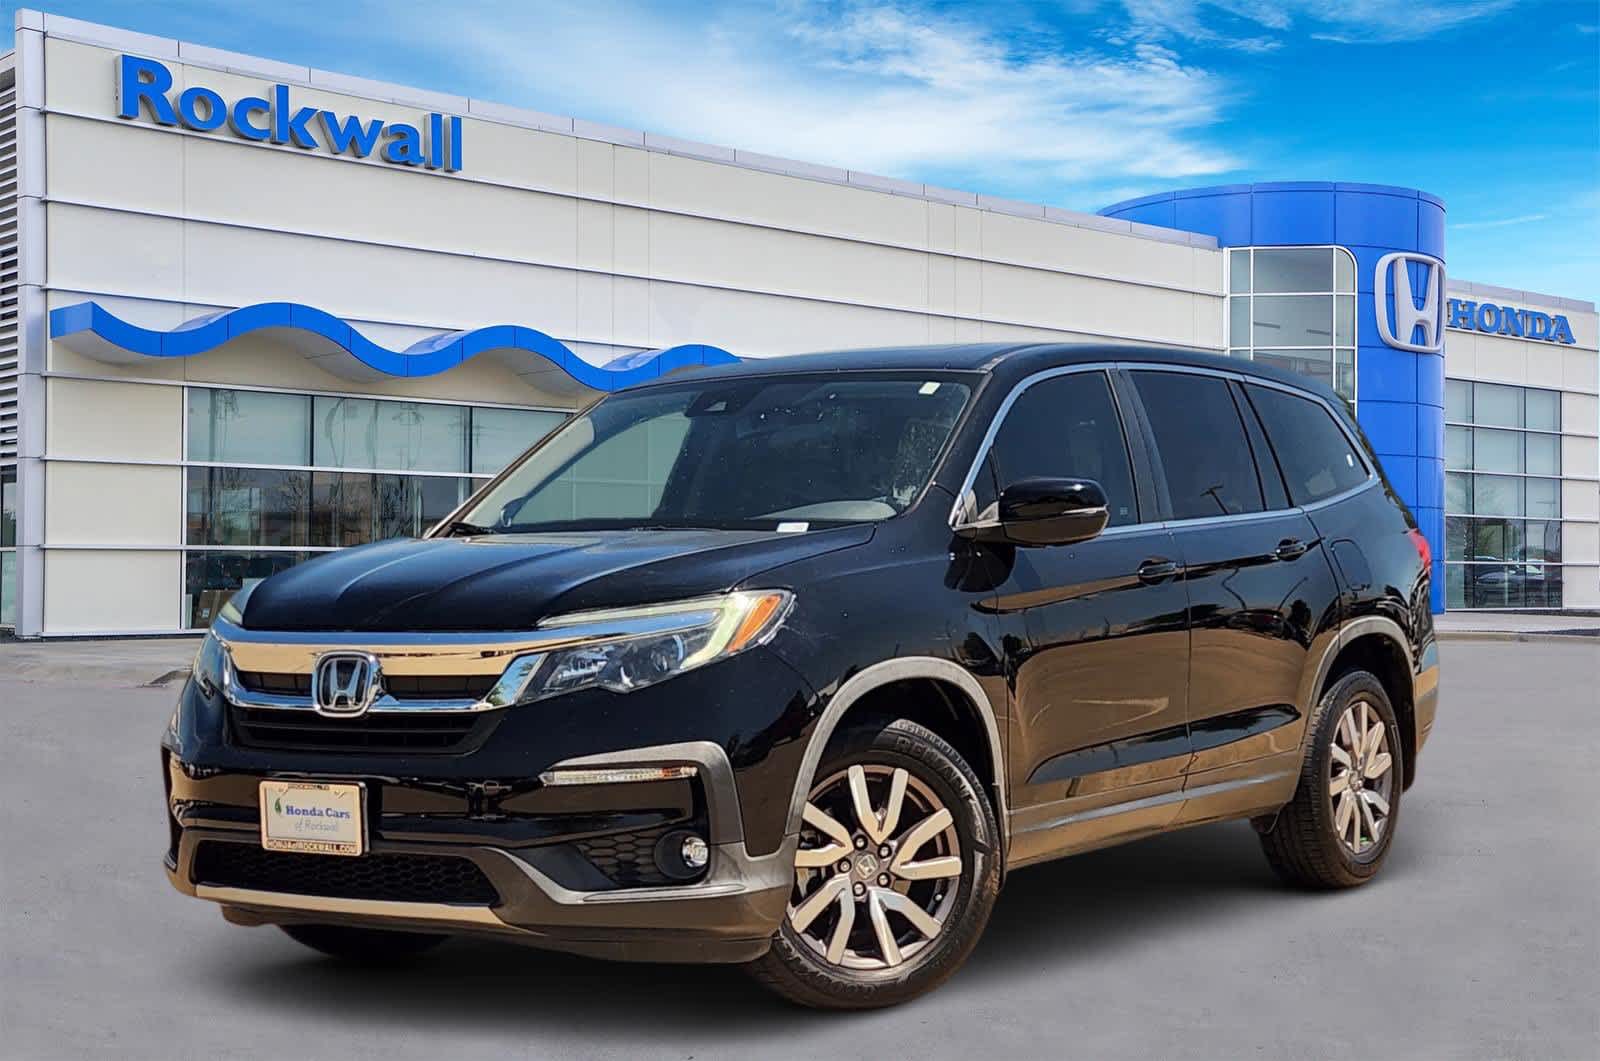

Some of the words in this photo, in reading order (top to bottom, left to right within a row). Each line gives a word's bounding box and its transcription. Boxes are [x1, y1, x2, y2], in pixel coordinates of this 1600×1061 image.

[118, 54, 463, 172] Rockwall
[1448, 298, 1577, 344] HONDA
[285, 805, 324, 817] Honda
[325, 807, 351, 819] Cars
